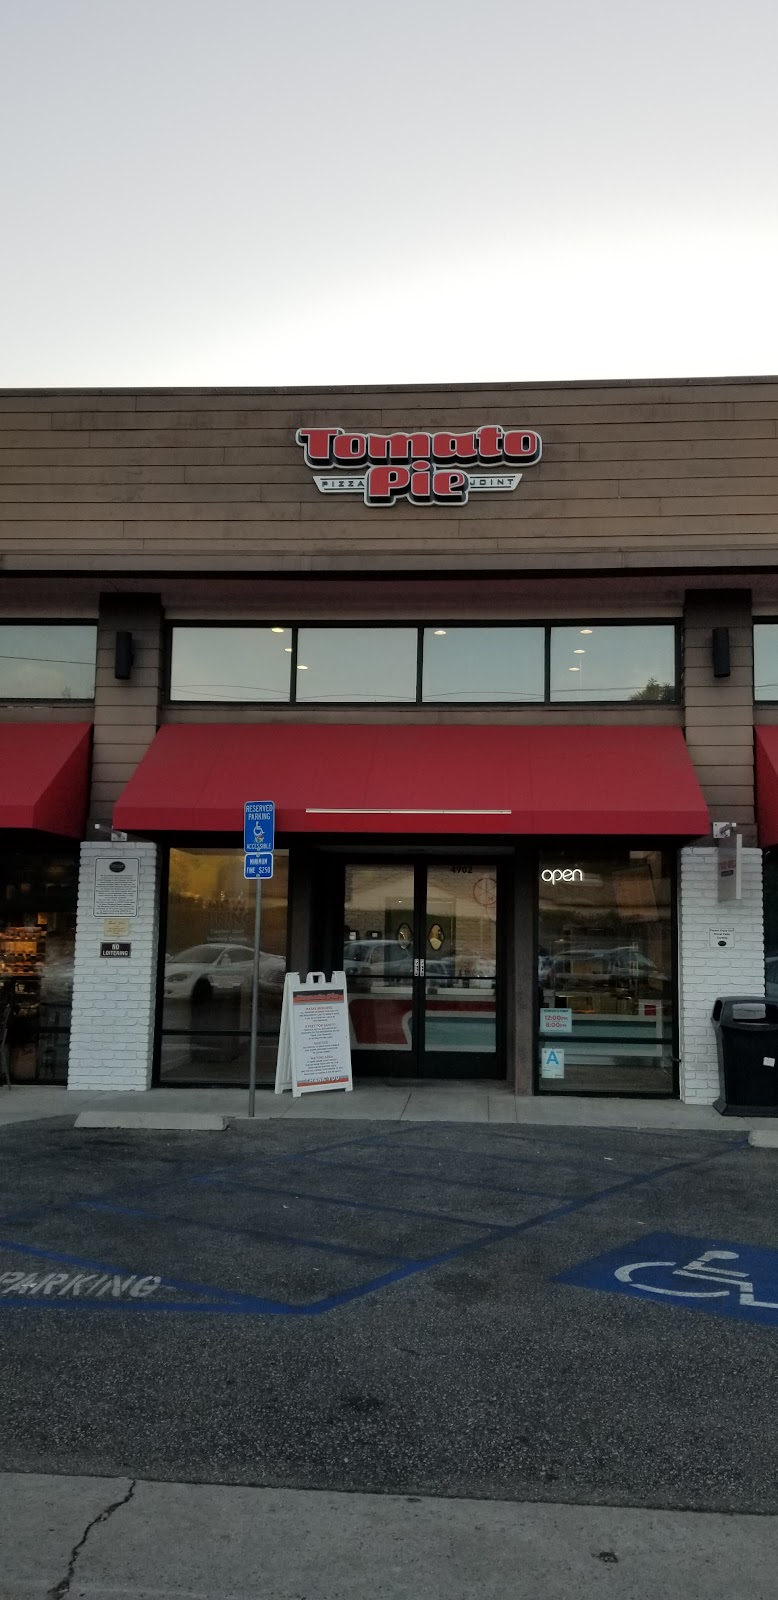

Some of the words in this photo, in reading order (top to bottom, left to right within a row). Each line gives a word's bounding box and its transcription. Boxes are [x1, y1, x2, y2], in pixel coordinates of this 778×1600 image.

[297, 425, 541, 464] Tomato
[321, 480, 365, 488] PIZZA
[367, 460, 467, 501] Pie
[470, 478, 514, 486] JOINT
[245, 804, 273, 813] RESERVED
[248, 812, 271, 821] PARKING
[246, 842, 272, 850] ACCESSIBLE
[249, 858, 268, 866] MINIMUM
[246, 866, 256, 874] FINE
[258, 866, 271, 874] $250
[450, 866, 473, 874] 4902
[541, 868, 583, 886] open
[545, 1050, 560, 1065] A
[0, 1271, 162, 1297] PARKING
